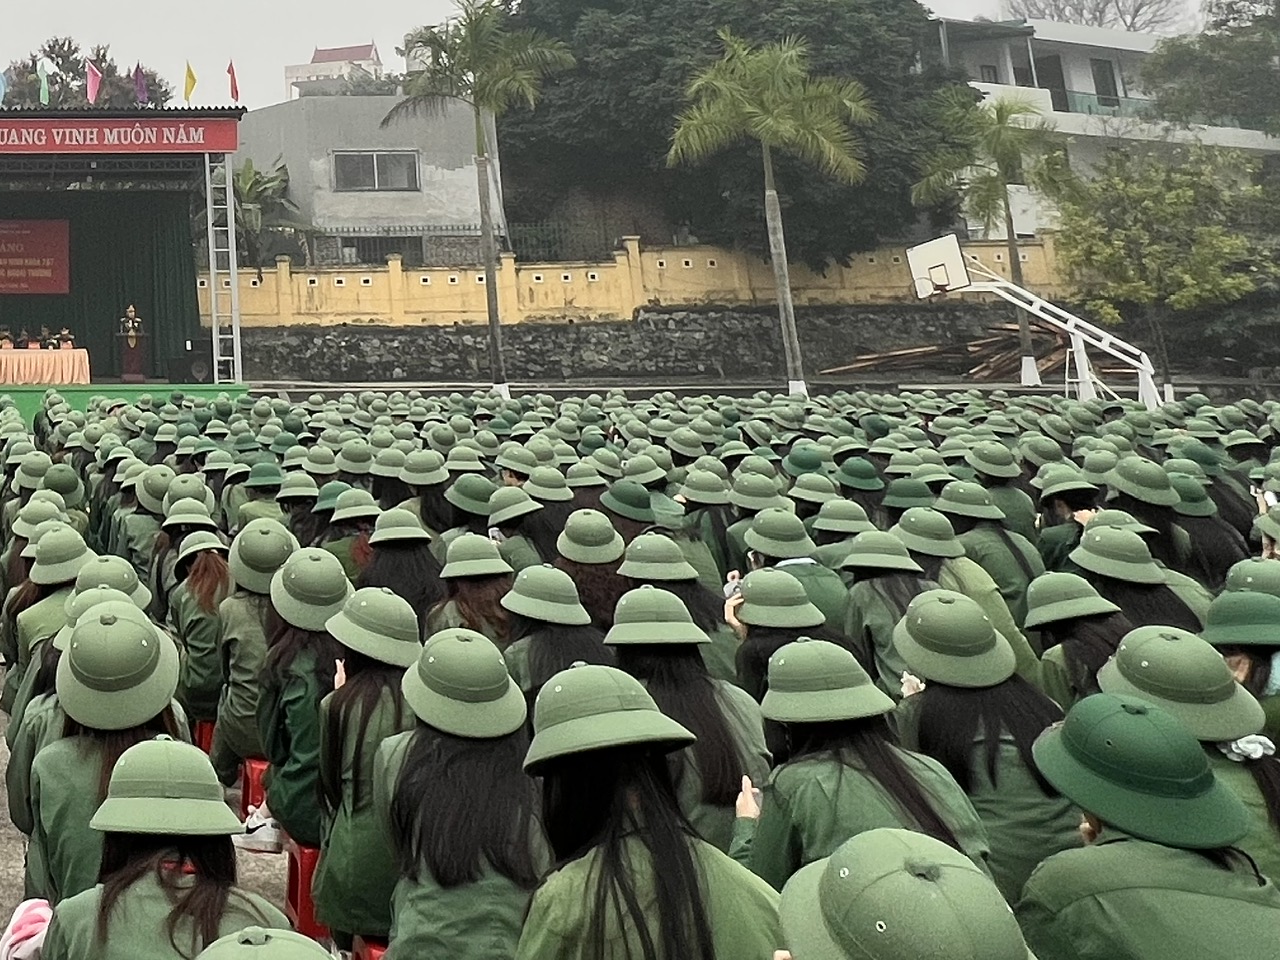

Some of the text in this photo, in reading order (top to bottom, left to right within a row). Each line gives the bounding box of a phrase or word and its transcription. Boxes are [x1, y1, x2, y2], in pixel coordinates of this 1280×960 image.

[51, 127, 99, 145] VINH
[103, 122, 158, 145] MUÔN
[161, 123, 205, 144] NĂM
